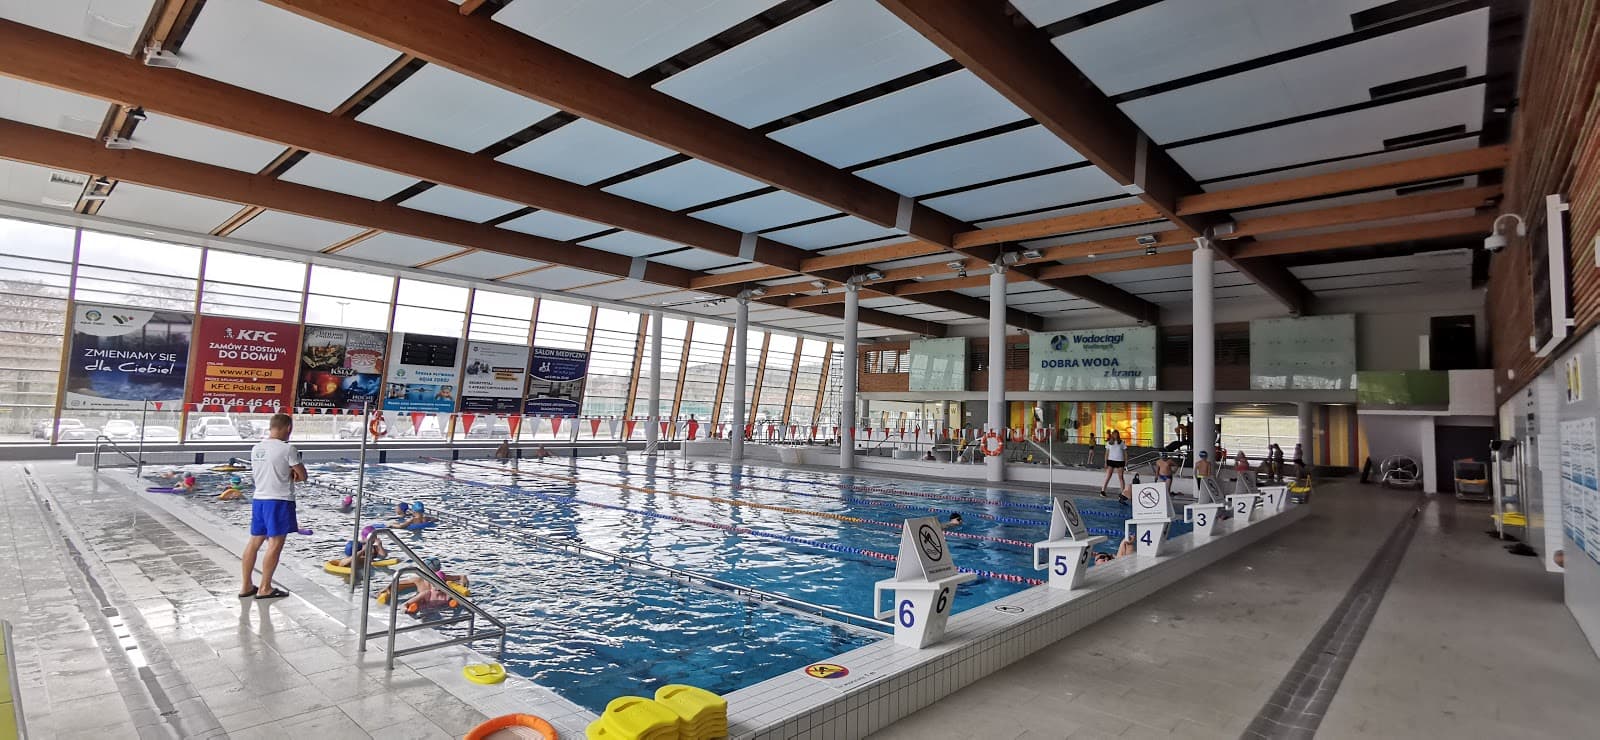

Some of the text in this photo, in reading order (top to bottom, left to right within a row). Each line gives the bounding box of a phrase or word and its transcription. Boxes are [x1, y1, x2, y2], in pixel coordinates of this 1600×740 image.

[237, 329, 277, 342] KFC
[85, 348, 176, 362] ZMIENIAMY SIĘ
[209, 342, 242, 351] ZAMÓW
[250, 345, 286, 355] DOSTAWĄ
[218, 350, 278, 361] DO DOMU
[85, 360, 174, 374] dla Ciebie!
[1042, 358, 1119, 369] DOBRA WODA
[219, 369, 273, 378] www.KFC.pl
[1112, 368, 1141, 377] kranu
[202, 397, 225, 406] 801
[228, 398, 244, 406] 46
[265, 399, 281, 407] 46
[1268, 494, 1274, 504] 1
[1237, 502, 1246, 514] 2
[1196, 513, 1207, 527] 3
[1140, 529, 1153, 546] 4
[1054, 555, 1068, 576] 5
[936, 586, 950, 614] 6
[899, 599, 915, 628] 6
